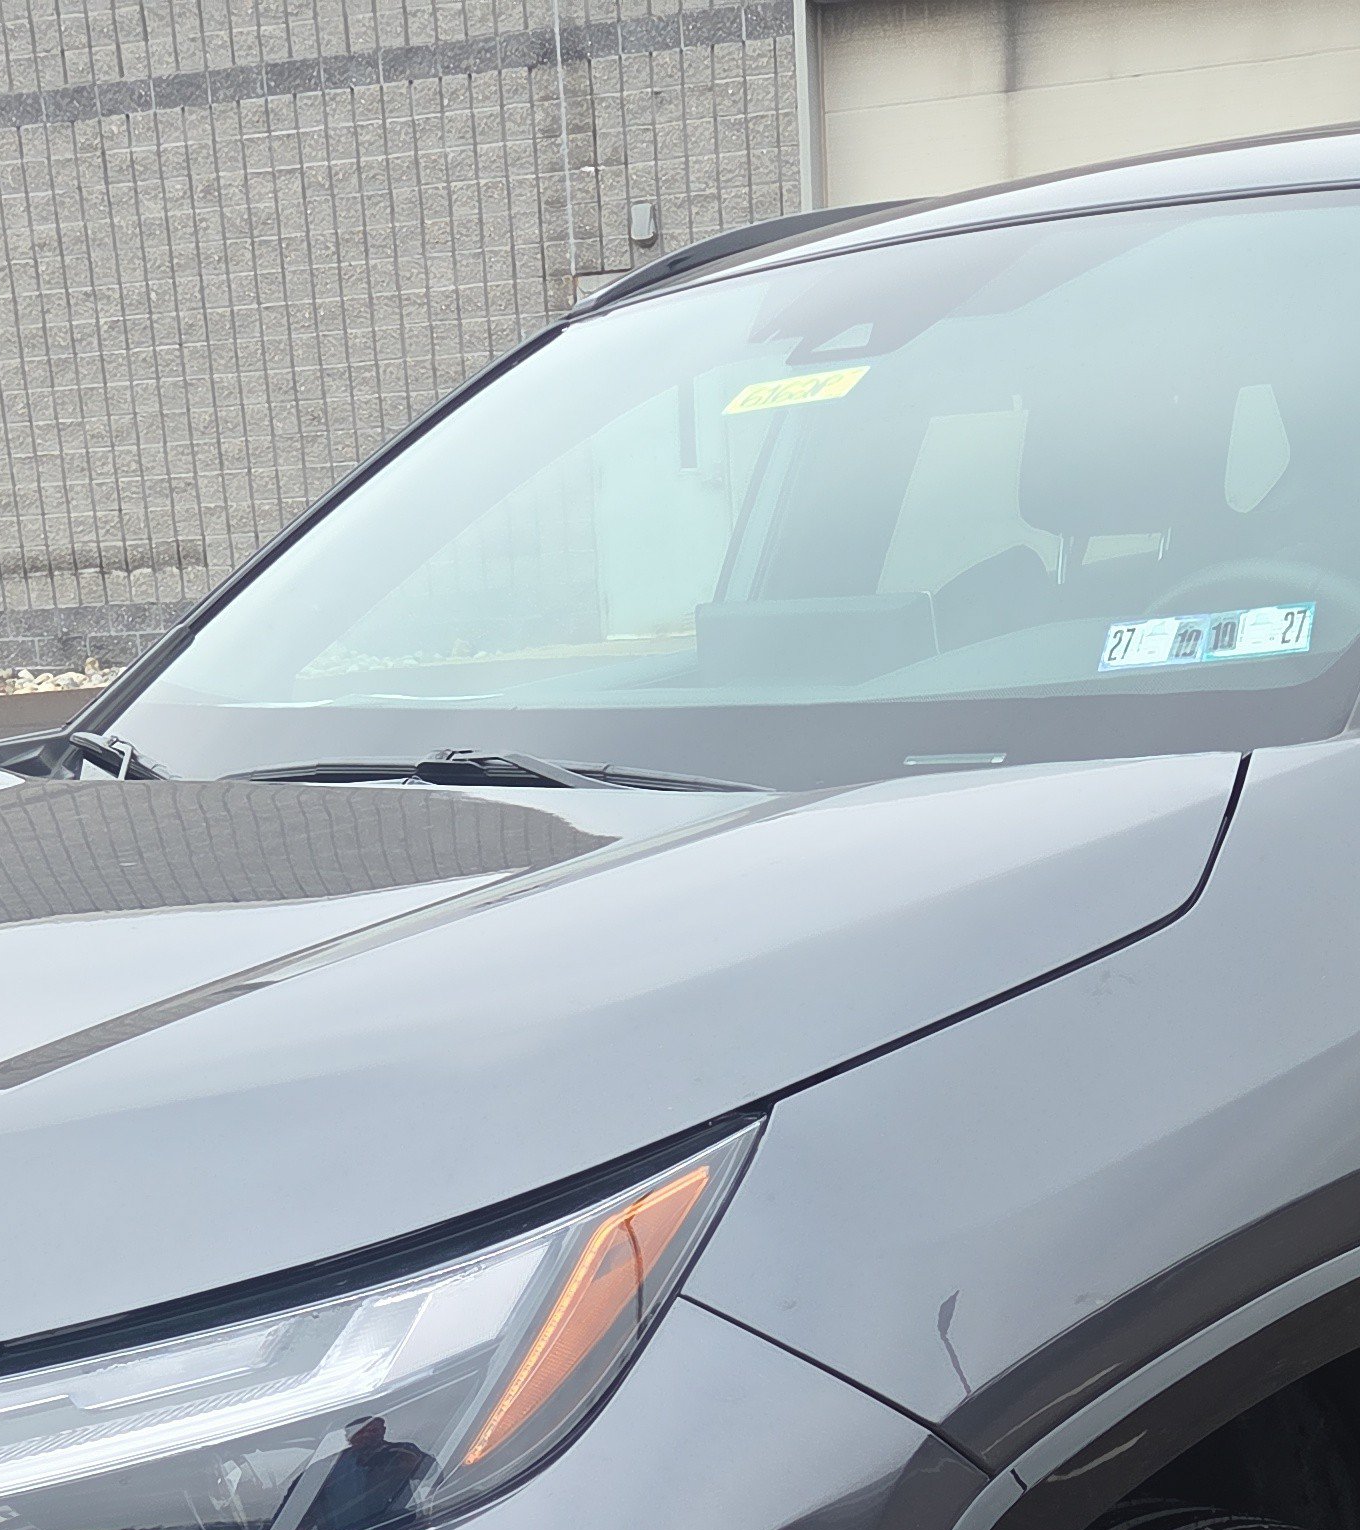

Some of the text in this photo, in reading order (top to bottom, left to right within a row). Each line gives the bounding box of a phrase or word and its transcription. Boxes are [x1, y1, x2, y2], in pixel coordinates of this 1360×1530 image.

[1107, 628, 1136, 661] 27
[1175, 629, 1203, 658] 10
[1210, 621, 1237, 650] 10
[1281, 609, 1308, 644] 27
